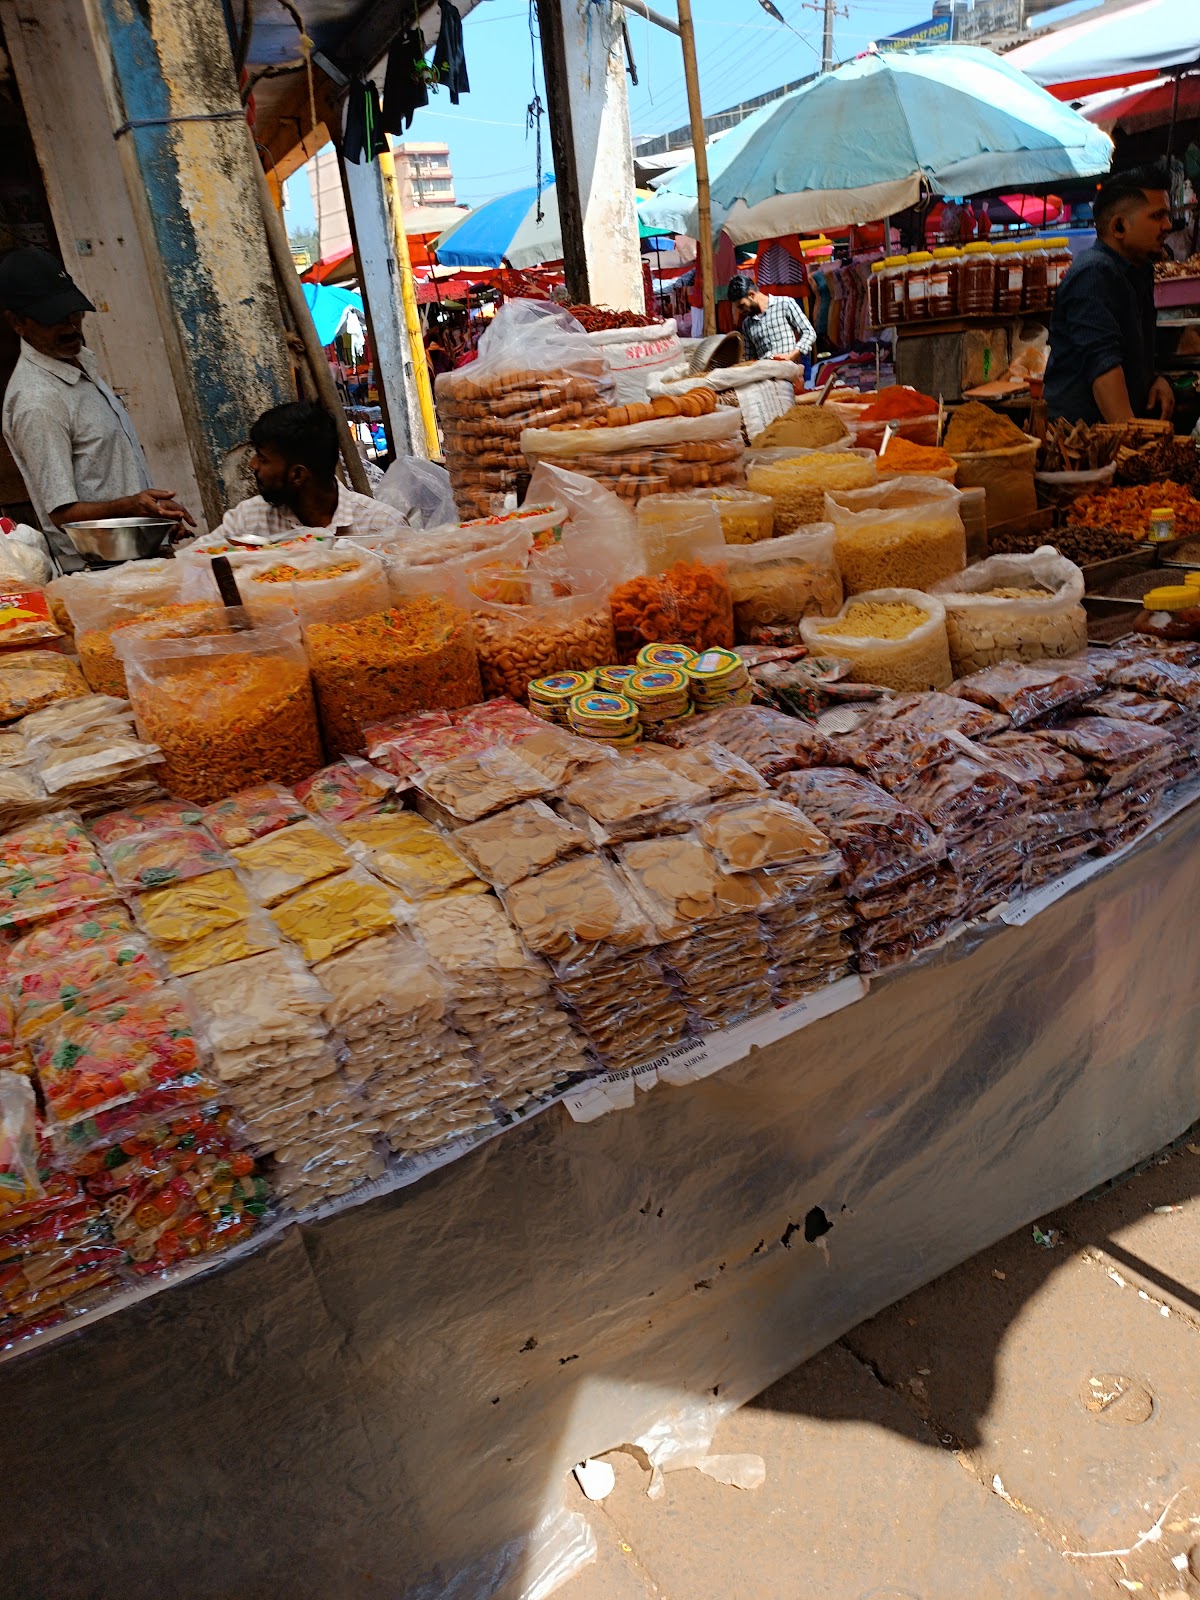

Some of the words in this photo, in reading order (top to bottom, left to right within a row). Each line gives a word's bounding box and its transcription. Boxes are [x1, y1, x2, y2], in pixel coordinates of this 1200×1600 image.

[911, 30, 927, 42] FAST
[928, 22, 949, 37] FOOD
[631, 1056, 669, 1077] Germany
[683, 1052, 708, 1069] SPORTS
